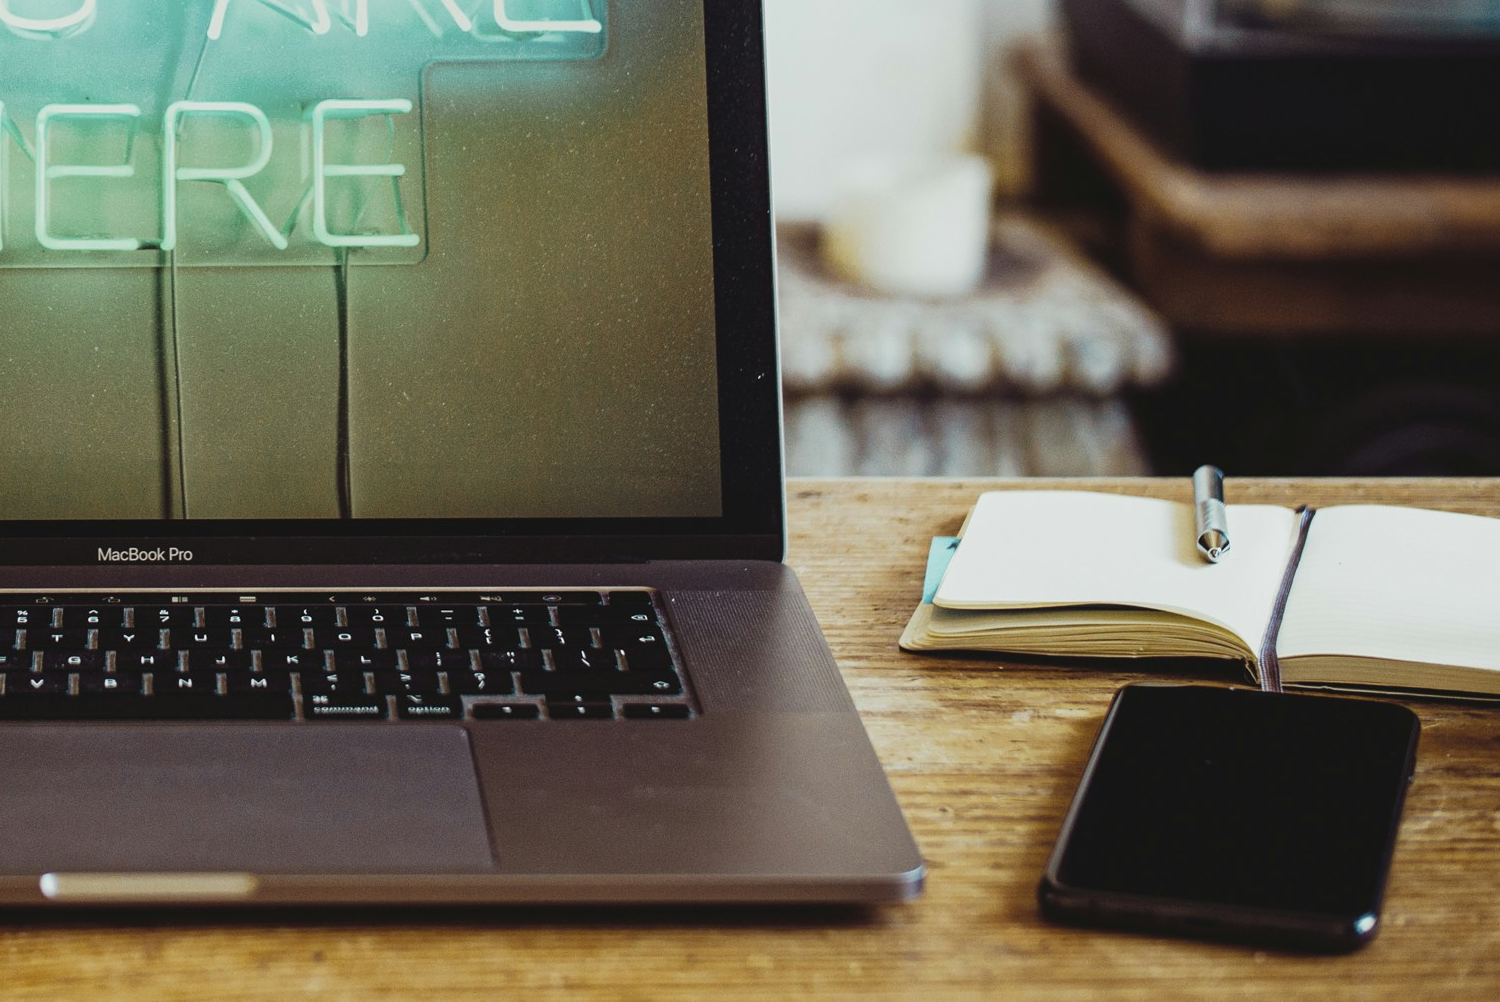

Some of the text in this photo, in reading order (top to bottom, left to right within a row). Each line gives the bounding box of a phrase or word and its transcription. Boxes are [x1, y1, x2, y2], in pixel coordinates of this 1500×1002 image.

[98, 547, 193, 561] MacBook Pro
[51, 634, 64, 643] T
[123, 634, 136, 643] Y
[194, 634, 208, 642] U
[270, 633, 276, 642] I
[338, 632, 352, 641] O
[410, 632, 423, 641] P
[67, 655, 82, 665] G
[140, 655, 155, 665] H
[215, 655, 226, 664] J
[286, 655, 299, 664] K
[360, 655, 372, 664] L
[30, 678, 44, 689] V
[104, 678, 118, 688] B
[178, 678, 193, 688] N
[250, 678, 268, 688] M
[313, 705, 379, 715] command
[407, 706, 451, 716] option
